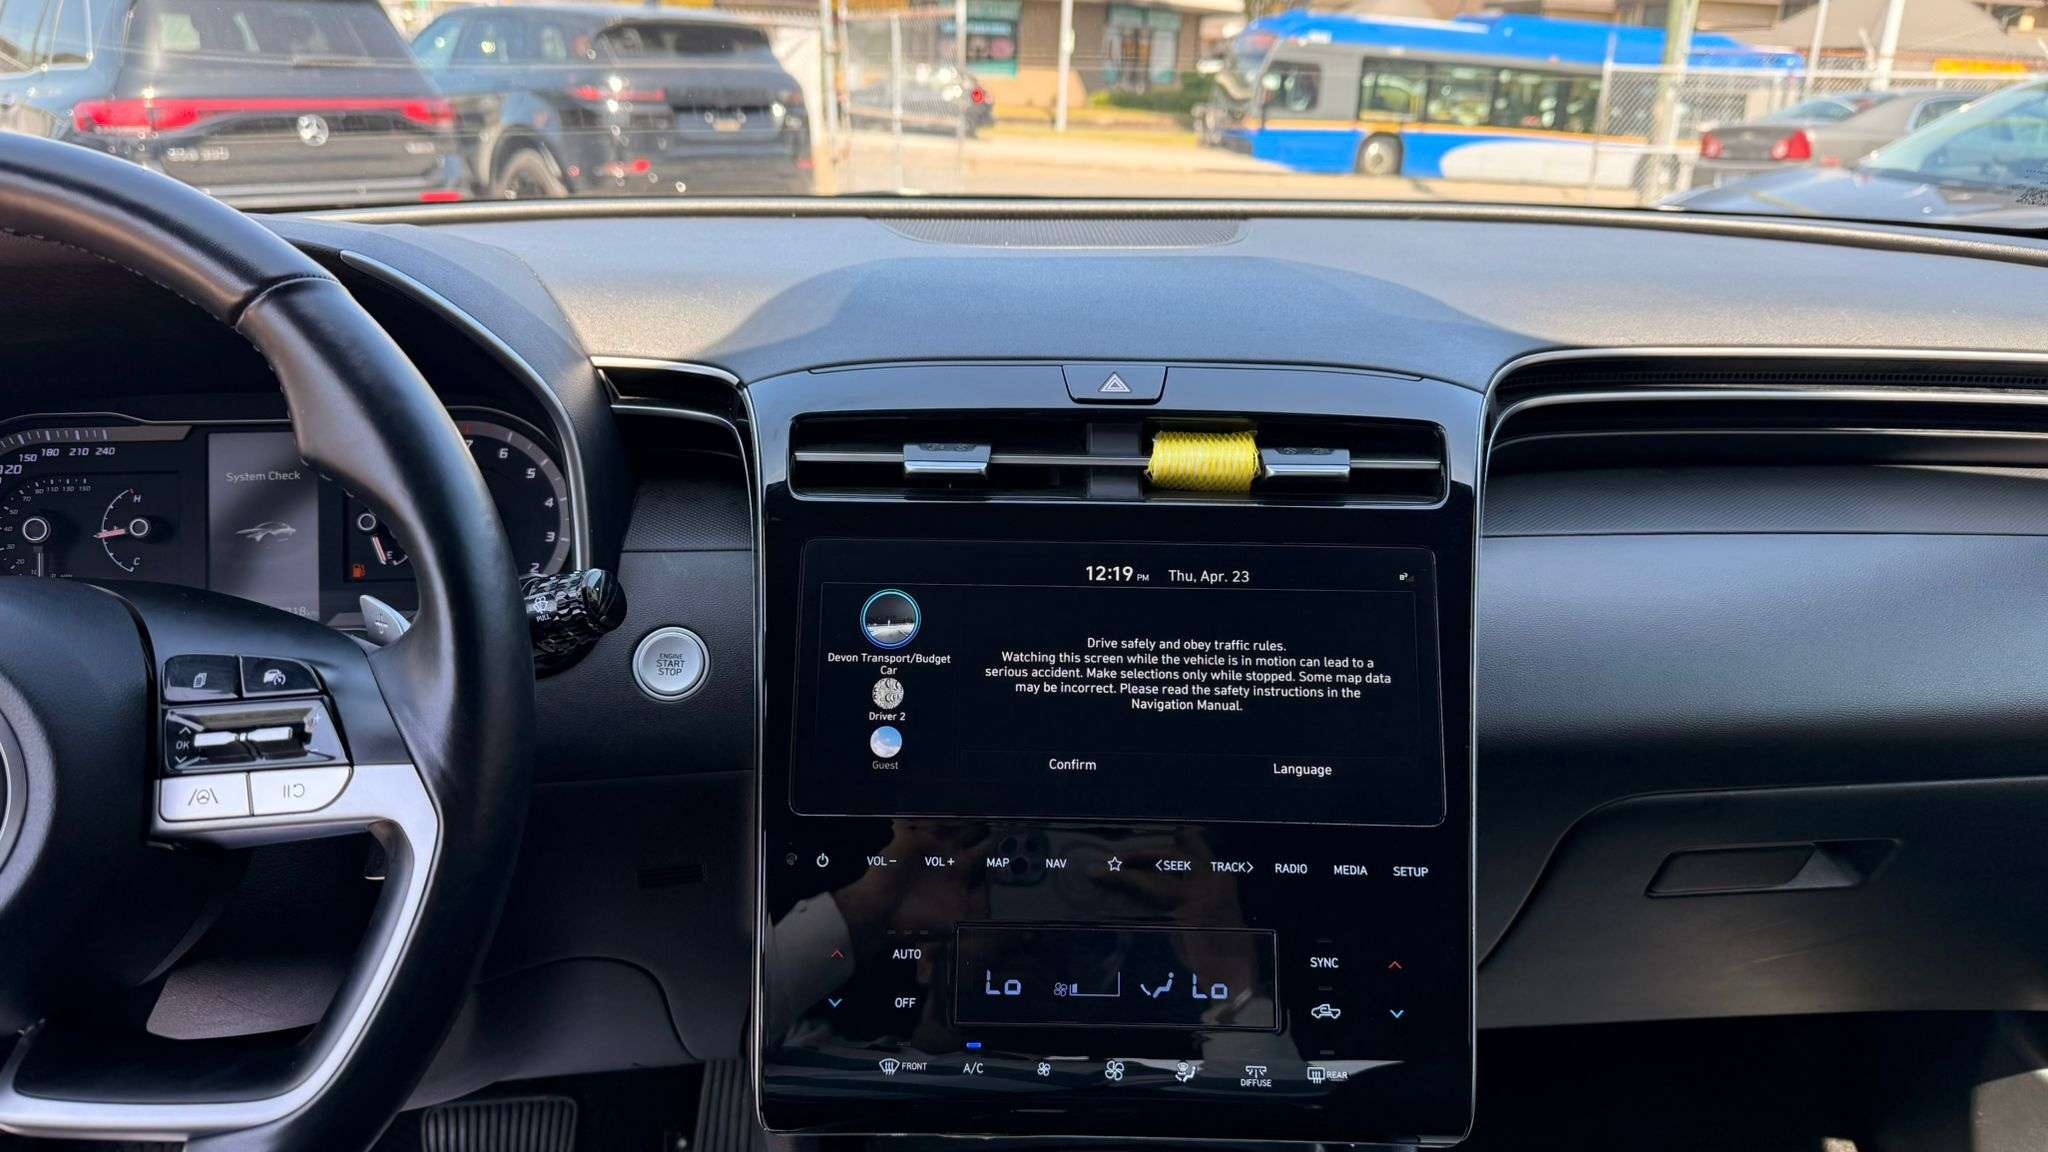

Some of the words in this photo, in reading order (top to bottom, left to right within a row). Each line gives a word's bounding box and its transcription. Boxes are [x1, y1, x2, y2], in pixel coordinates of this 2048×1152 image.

[41, 448, 59, 456] 180
[69, 448, 89, 456] 210
[95, 447, 115, 455] 240
[499, 448, 508, 458] 6
[19, 454, 37, 462] 150
[225, 471, 265, 483] System
[268, 471, 300, 480] Check
[526, 468, 536, 479] 5
[544, 498, 554, 508] 4
[545, 532, 555, 542] 3
[133, 558, 140, 566] C
[530, 563, 539, 573] 2
[1086, 566, 1133, 581] 12:19
[1168, 570, 1196, 582] Thu,
[1201, 570, 1227, 584] Apr.
[1233, 571, 1249, 582] 23
[536, 611, 551, 622] PULL
[1088, 638, 1117, 648] Drive
[1121, 638, 1156, 651] safely
[1159, 639, 1180, 649] and
[1184, 639, 1211, 652] obey
[1215, 640, 1249, 650] traffic
[1254, 641, 1286, 651] rules.
[828, 653, 858, 662] Devon
[861, 653, 950, 665] Transport/Budget
[1002, 651, 1055, 665] Watching
[1059, 652, 1080, 663] this
[1084, 655, 1123, 663] screen
[1127, 654, 1158, 664] while
[1161, 654, 1180, 664] the
[1183, 655, 1224, 665] vehicle
[1229, 655, 1238, 665] is
[1242, 655, 1251, 665] in
[1256, 656, 1296, 666] motion
[1324, 657, 1348, 667] lead
[1352, 658, 1363, 668] to
[1367, 660, 1374, 668] a
[880, 666, 897, 674] Car
[986, 666, 1028, 677] serious
[1032, 667, 1083, 678] accident.
[1087, 668, 1117, 678] Make
[1121, 668, 1179, 679] selections
[1183, 670, 1208, 682] only
[1211, 670, 1242, 680] while
[1246, 671, 1295, 683] stopped.
[1299, 671, 1332, 682] Some
[1336, 675, 1362, 685] map
[1365, 673, 1391, 683] data
[1016, 684, 1040, 694] may
[1044, 682, 1057, 692] be
[1061, 682, 1116, 693] incorrect.
[1120, 683, 1158, 694] Please
[1162, 685, 1188, 694] read
[1192, 685, 1210, 695] the
[1214, 685, 1249, 698] safety
[1253, 686, 1324, 697] instructions
[1328, 687, 1337, 697] in
[1342, 687, 1360, 698] the
[1132, 699, 1193, 711] Navigation
[1197, 700, 1242, 711] Manual.
[869, 712, 897, 720] Driver
[900, 712, 905, 720] 2
[176, 740, 190, 750] OK
[873, 761, 898, 769] Guest
[1049, 759, 1096, 770] Confirm
[1274, 763, 1332, 777] Language
[987, 858, 1009, 867] MAP
[1046, 859, 1066, 868] NAV
[1275, 863, 1307, 873] RADIO
[1334, 865, 1367, 875] MEDIA
[1393, 866, 1428, 877] SETUP
[893, 949, 921, 959] AUTO
[1311, 957, 1338, 968] SYNC
[895, 998, 916, 1008] OFF
[902, 1062, 927, 1070] FRONT
[963, 1062, 983, 1074] A/C
[1326, 1071, 1348, 1080] REAR
[1241, 1079, 1271, 1087] DIFFUSE
